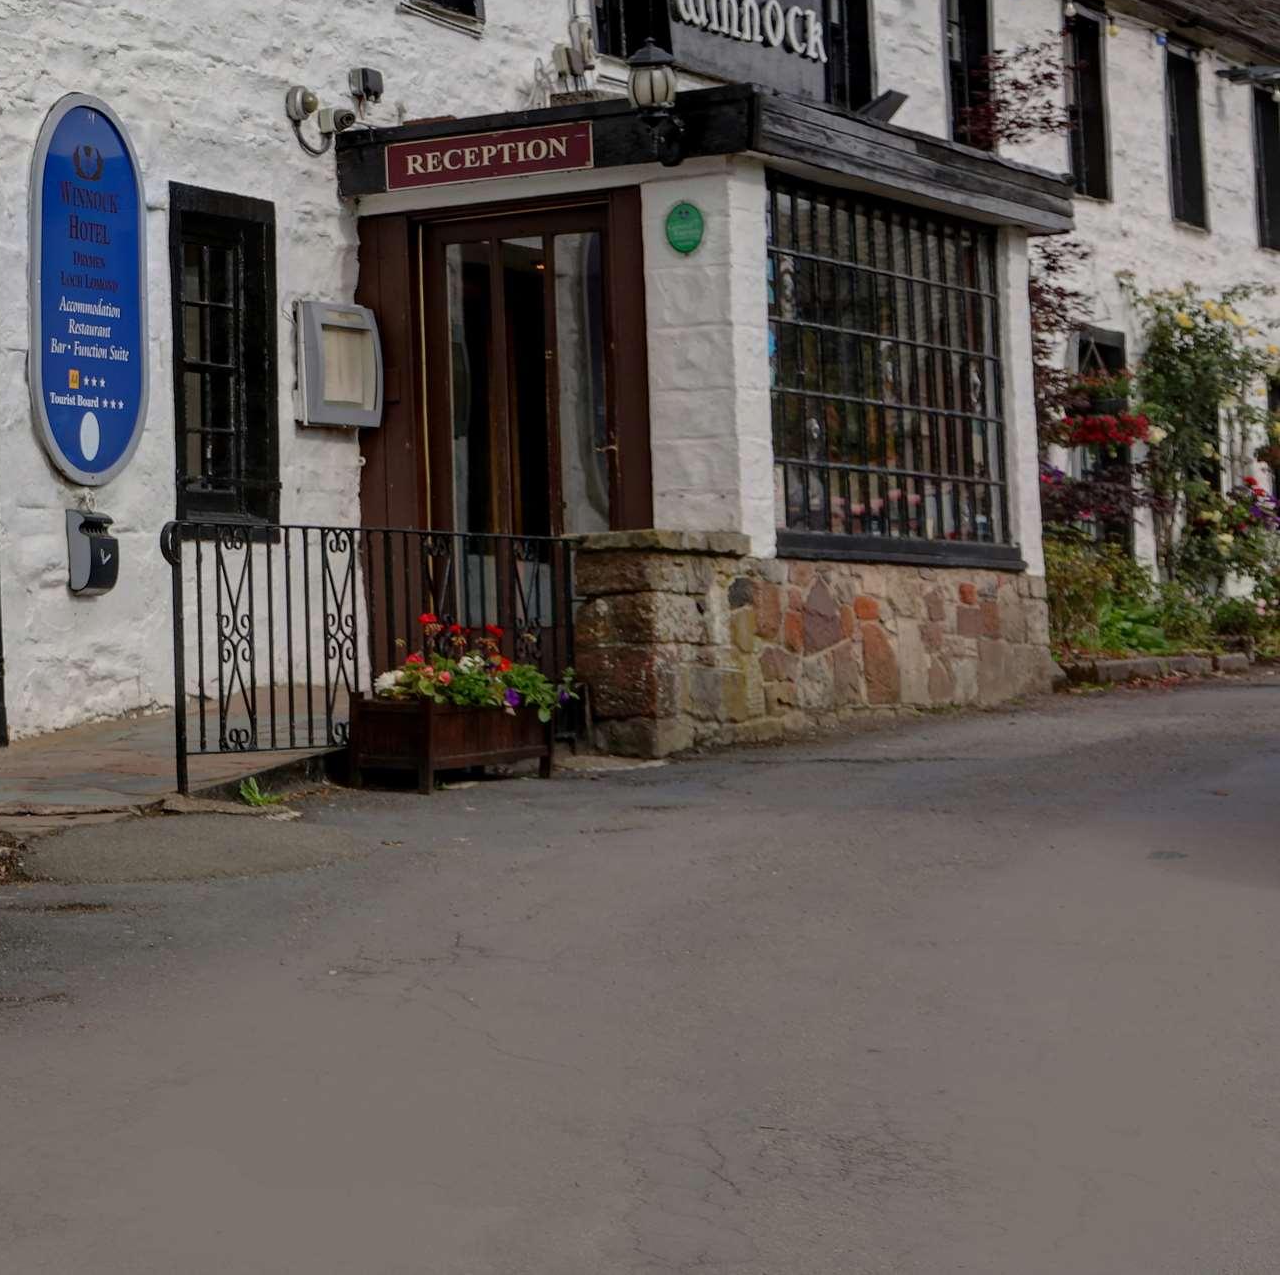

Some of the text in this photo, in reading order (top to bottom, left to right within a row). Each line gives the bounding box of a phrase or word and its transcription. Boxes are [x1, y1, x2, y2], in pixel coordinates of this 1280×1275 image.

[406, 136, 568, 175] RECEPTION
[59, 181, 119, 213] WINNOCK
[69, 213, 110, 245] HOTEL
[59, 295, 121, 319] Accommodation
[68, 319, 111, 338] Restaurant
[50, 338, 130, 362] Bar Function Suite
[50, 392, 99, 408] Tourist Board
